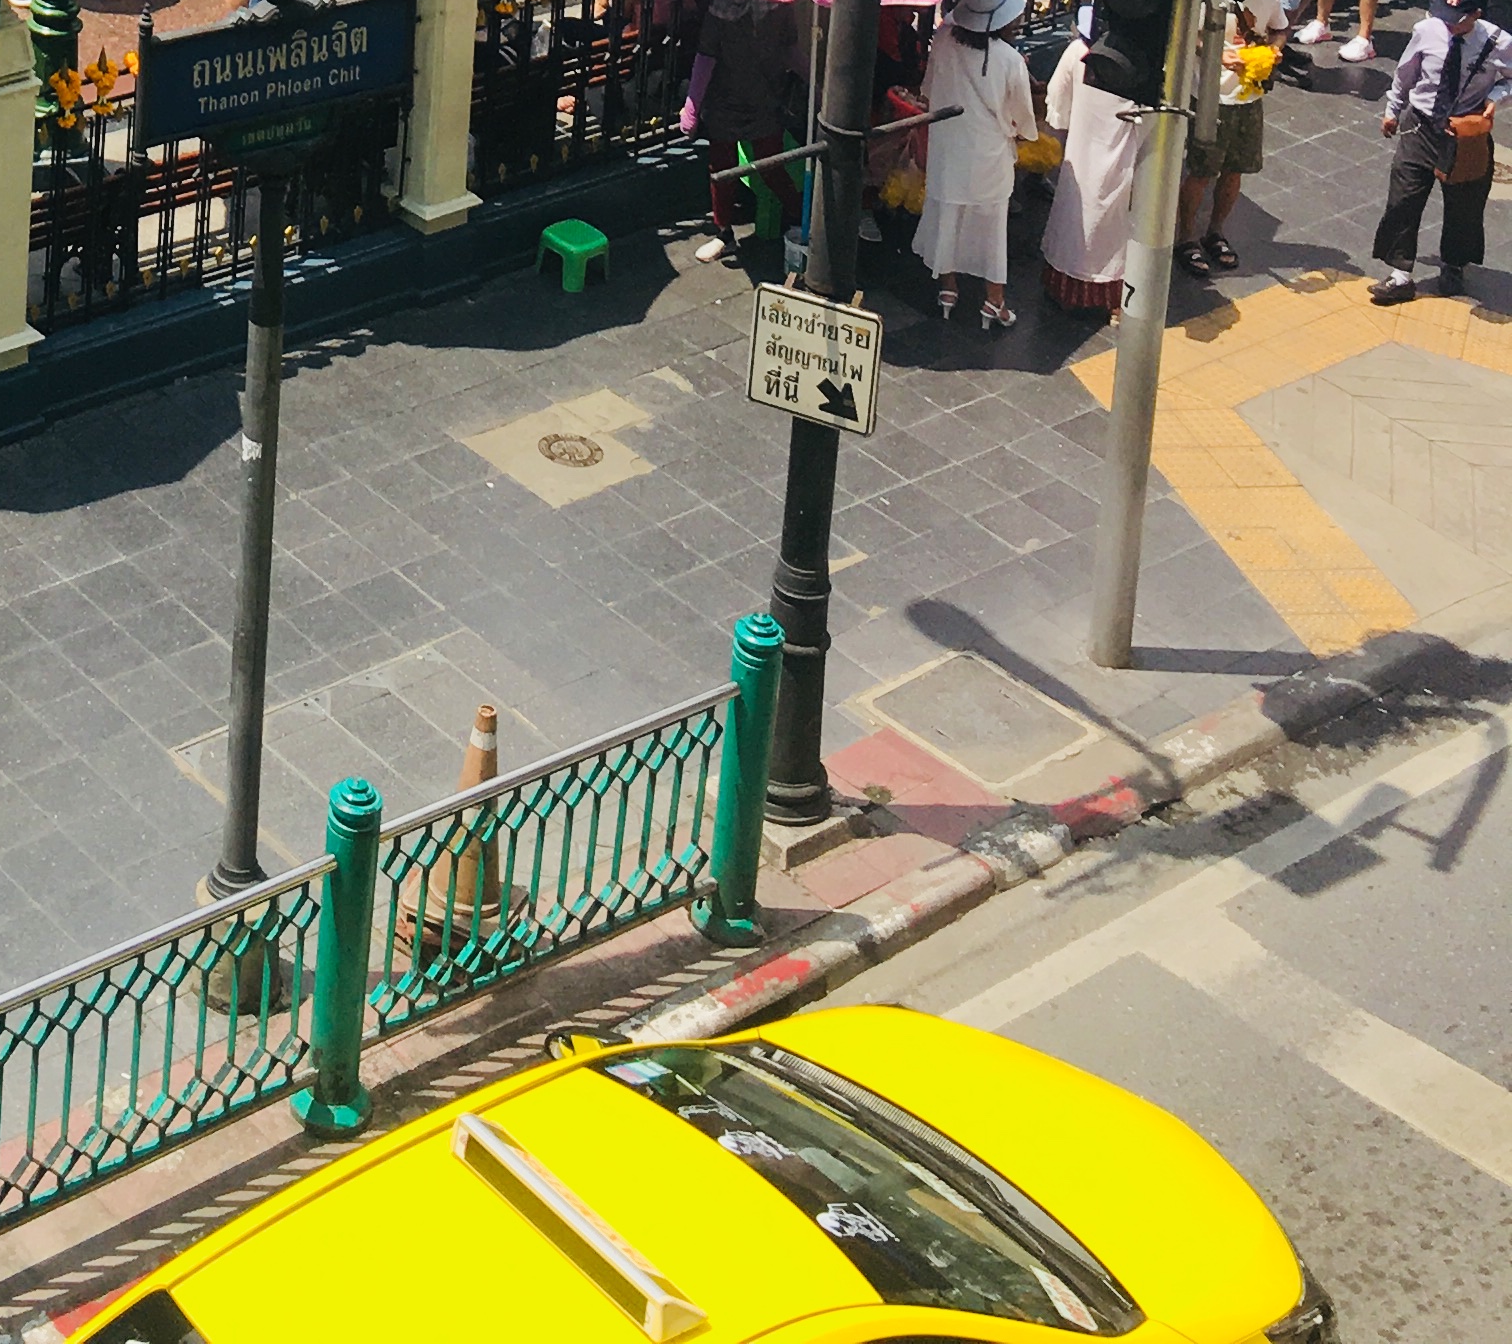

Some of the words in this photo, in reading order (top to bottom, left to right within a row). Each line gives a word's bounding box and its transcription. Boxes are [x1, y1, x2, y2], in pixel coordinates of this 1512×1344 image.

[192, 20, 368, 89] ถนนเพลินจิต
[197, 89, 259, 114] Thanon
[265, 74, 322, 100] Phloen
[328, 65, 361, 87] Chit
[764, 332, 864, 382] สัญญาณไฟ
[763, 365, 800, 404] ที่นี่
